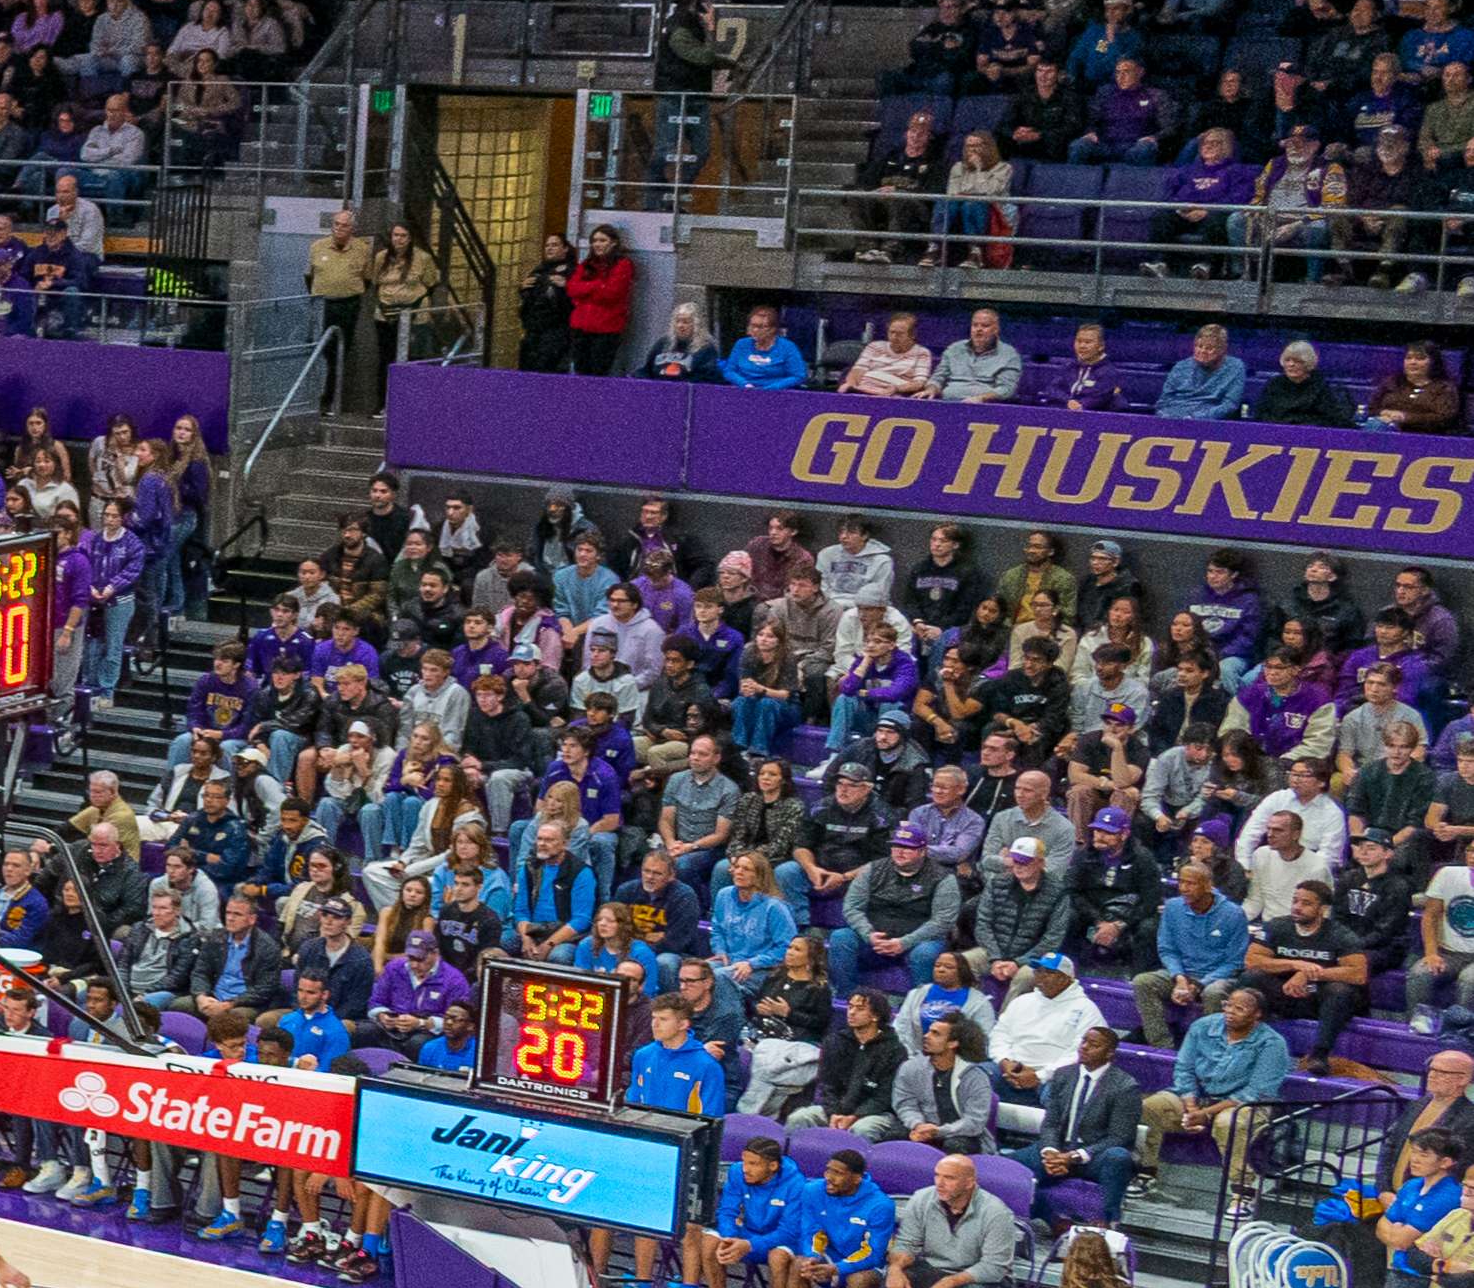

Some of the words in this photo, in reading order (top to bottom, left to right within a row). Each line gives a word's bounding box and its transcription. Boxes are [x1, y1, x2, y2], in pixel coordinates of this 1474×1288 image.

[790, 411, 936, 490] GO
[942, 421, 1474, 535] HUSKIES
[1277, 946, 1330, 960] ROGUE
[524, 983, 605, 1031] 5:22
[516, 1027, 585, 1080] 20
[497, 1075, 589, 1101] DAKTRONICS
[496, 1154, 597, 1205] king
